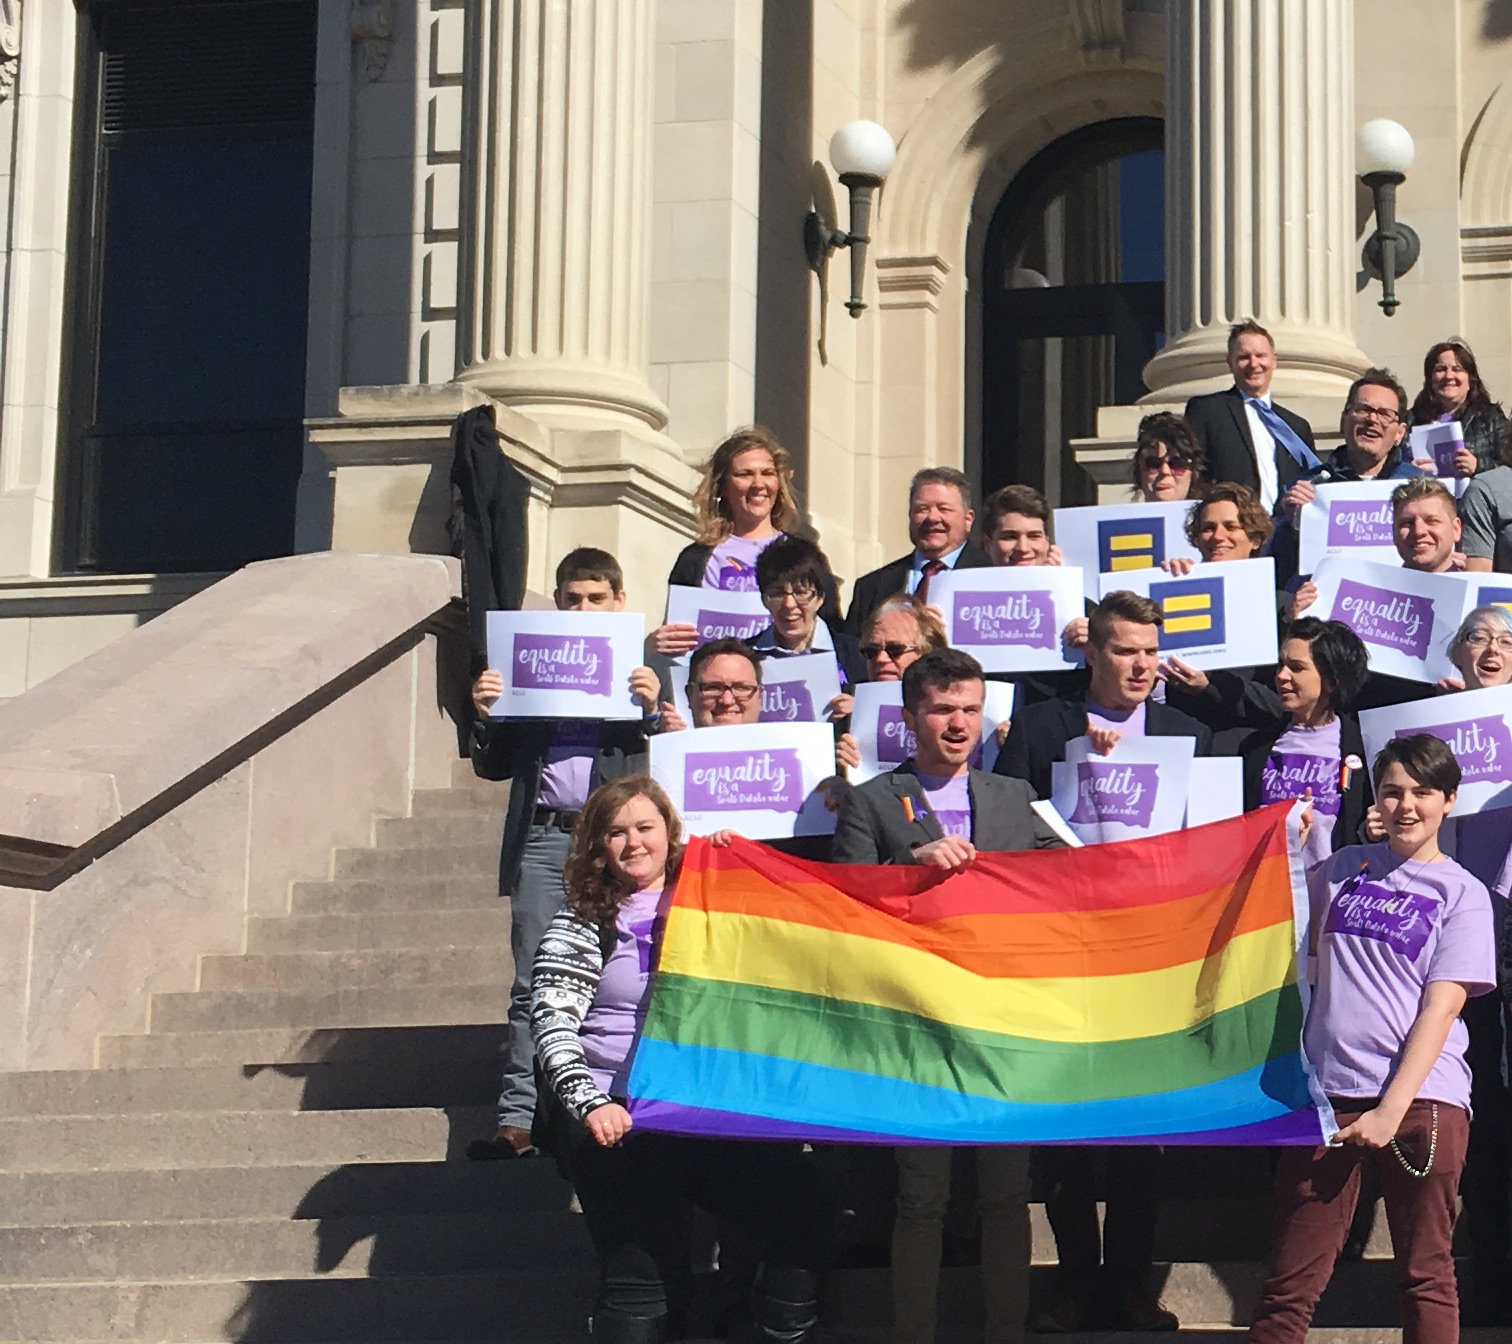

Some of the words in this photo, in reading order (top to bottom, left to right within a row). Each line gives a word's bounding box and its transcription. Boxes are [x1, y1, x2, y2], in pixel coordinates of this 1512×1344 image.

[1335, 504, 1394, 534] equali
[960, 593, 1045, 631] equality
[1341, 595, 1424, 637] equality
[1359, 613, 1370, 627] is
[1371, 618, 1378, 627] a
[703, 617, 772, 640] equalit
[981, 619, 991, 631] is
[993, 621, 1001, 629] a
[519, 638, 602, 676] equality
[537, 663, 547, 675] is
[548, 664, 556, 673] a
[692, 753, 791, 795] equality
[717, 782, 729, 794] is
[730, 783, 739, 793] a
[1363, 910, 1372, 918] a
